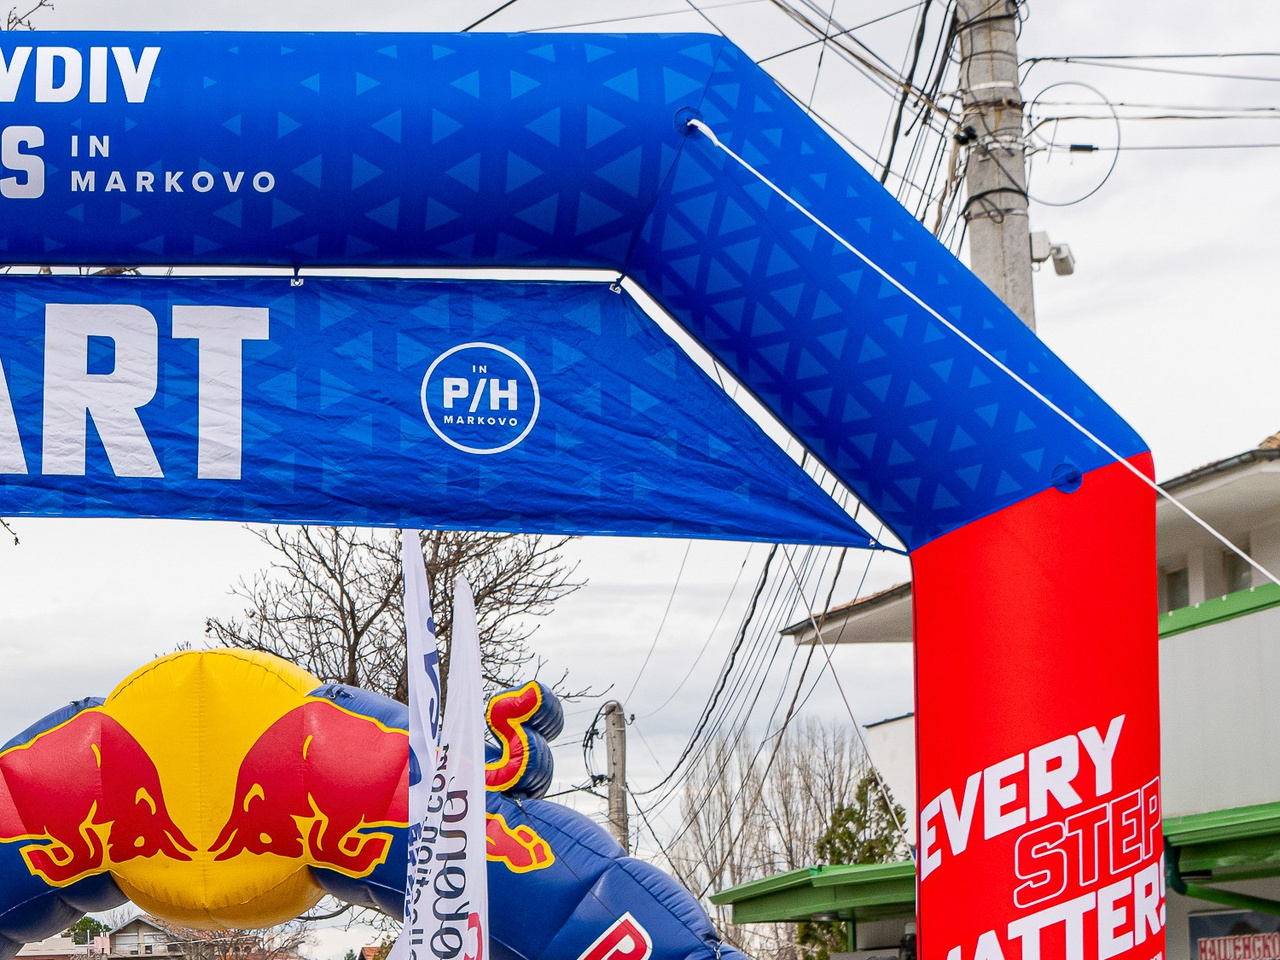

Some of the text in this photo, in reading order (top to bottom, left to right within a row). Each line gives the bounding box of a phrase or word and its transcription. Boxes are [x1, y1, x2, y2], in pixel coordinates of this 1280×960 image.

[71, 135, 110, 157] IN
[71, 170, 276, 193] MARKOVO
[472, 364, 487, 373] IN
[443, 377, 518, 413] P/H
[444, 415, 518, 427] MARKOVO
[921, 714, 1125, 882] EVERY
[1013, 776, 1162, 908] STEP
